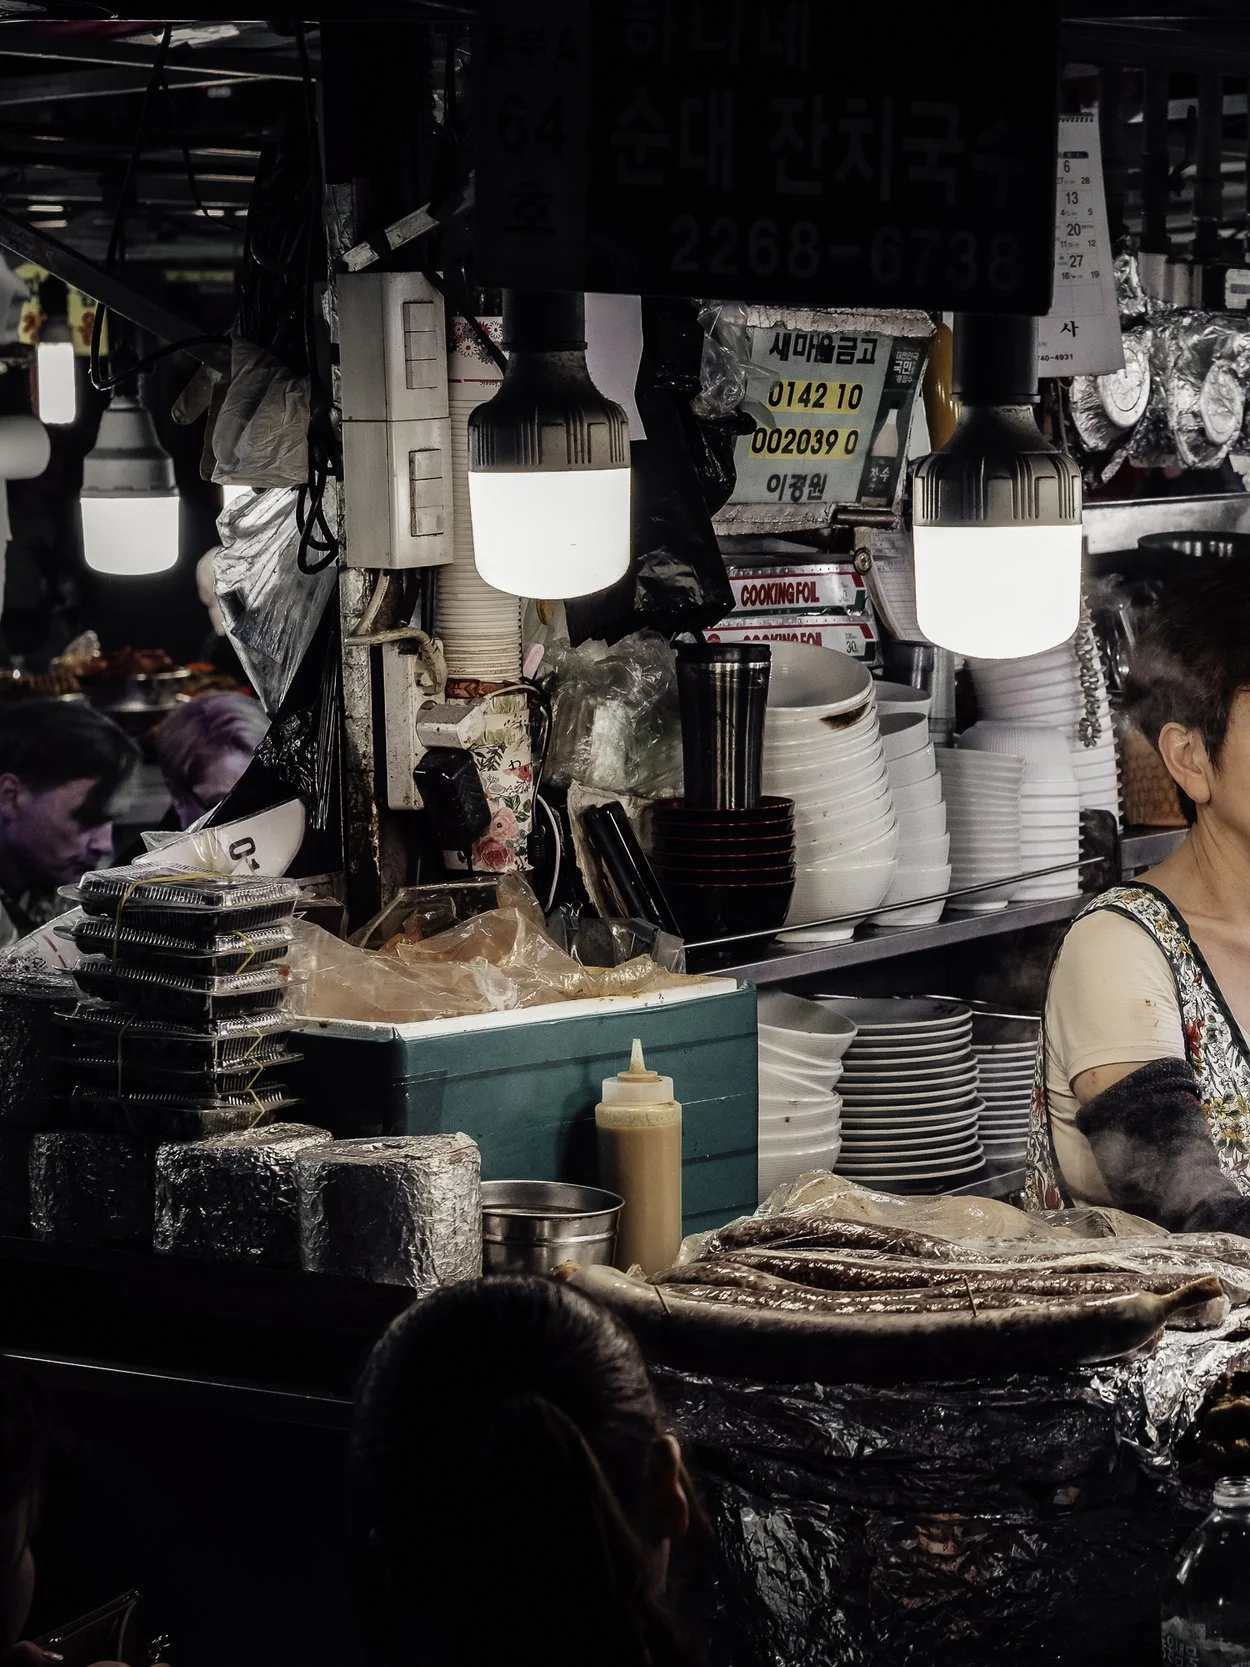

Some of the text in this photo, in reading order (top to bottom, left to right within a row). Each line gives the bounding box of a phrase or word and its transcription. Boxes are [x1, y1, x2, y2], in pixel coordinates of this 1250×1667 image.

[497, 94, 567, 156] 64
[609, 85, 1013, 208] 순대 잔치국수
[1063, 160, 1070, 173] 6
[503, 181, 557, 235] 호
[1065, 192, 1078, 205] 13
[1067, 223, 1081, 236] 20
[669, 214, 1022, 292] 2268-6738
[1069, 255, 1084, 268] 27
[1060, 320, 1079, 337] 사
[769, 332, 879, 365] 새마을금고
[768, 381, 864, 410] 0142 10
[751, 428, 859, 455] 002039 0
[766, 473, 829, 502] 이경원
[740, 583, 795, 607] COOKING
[795, 581, 820, 604] FOIL
